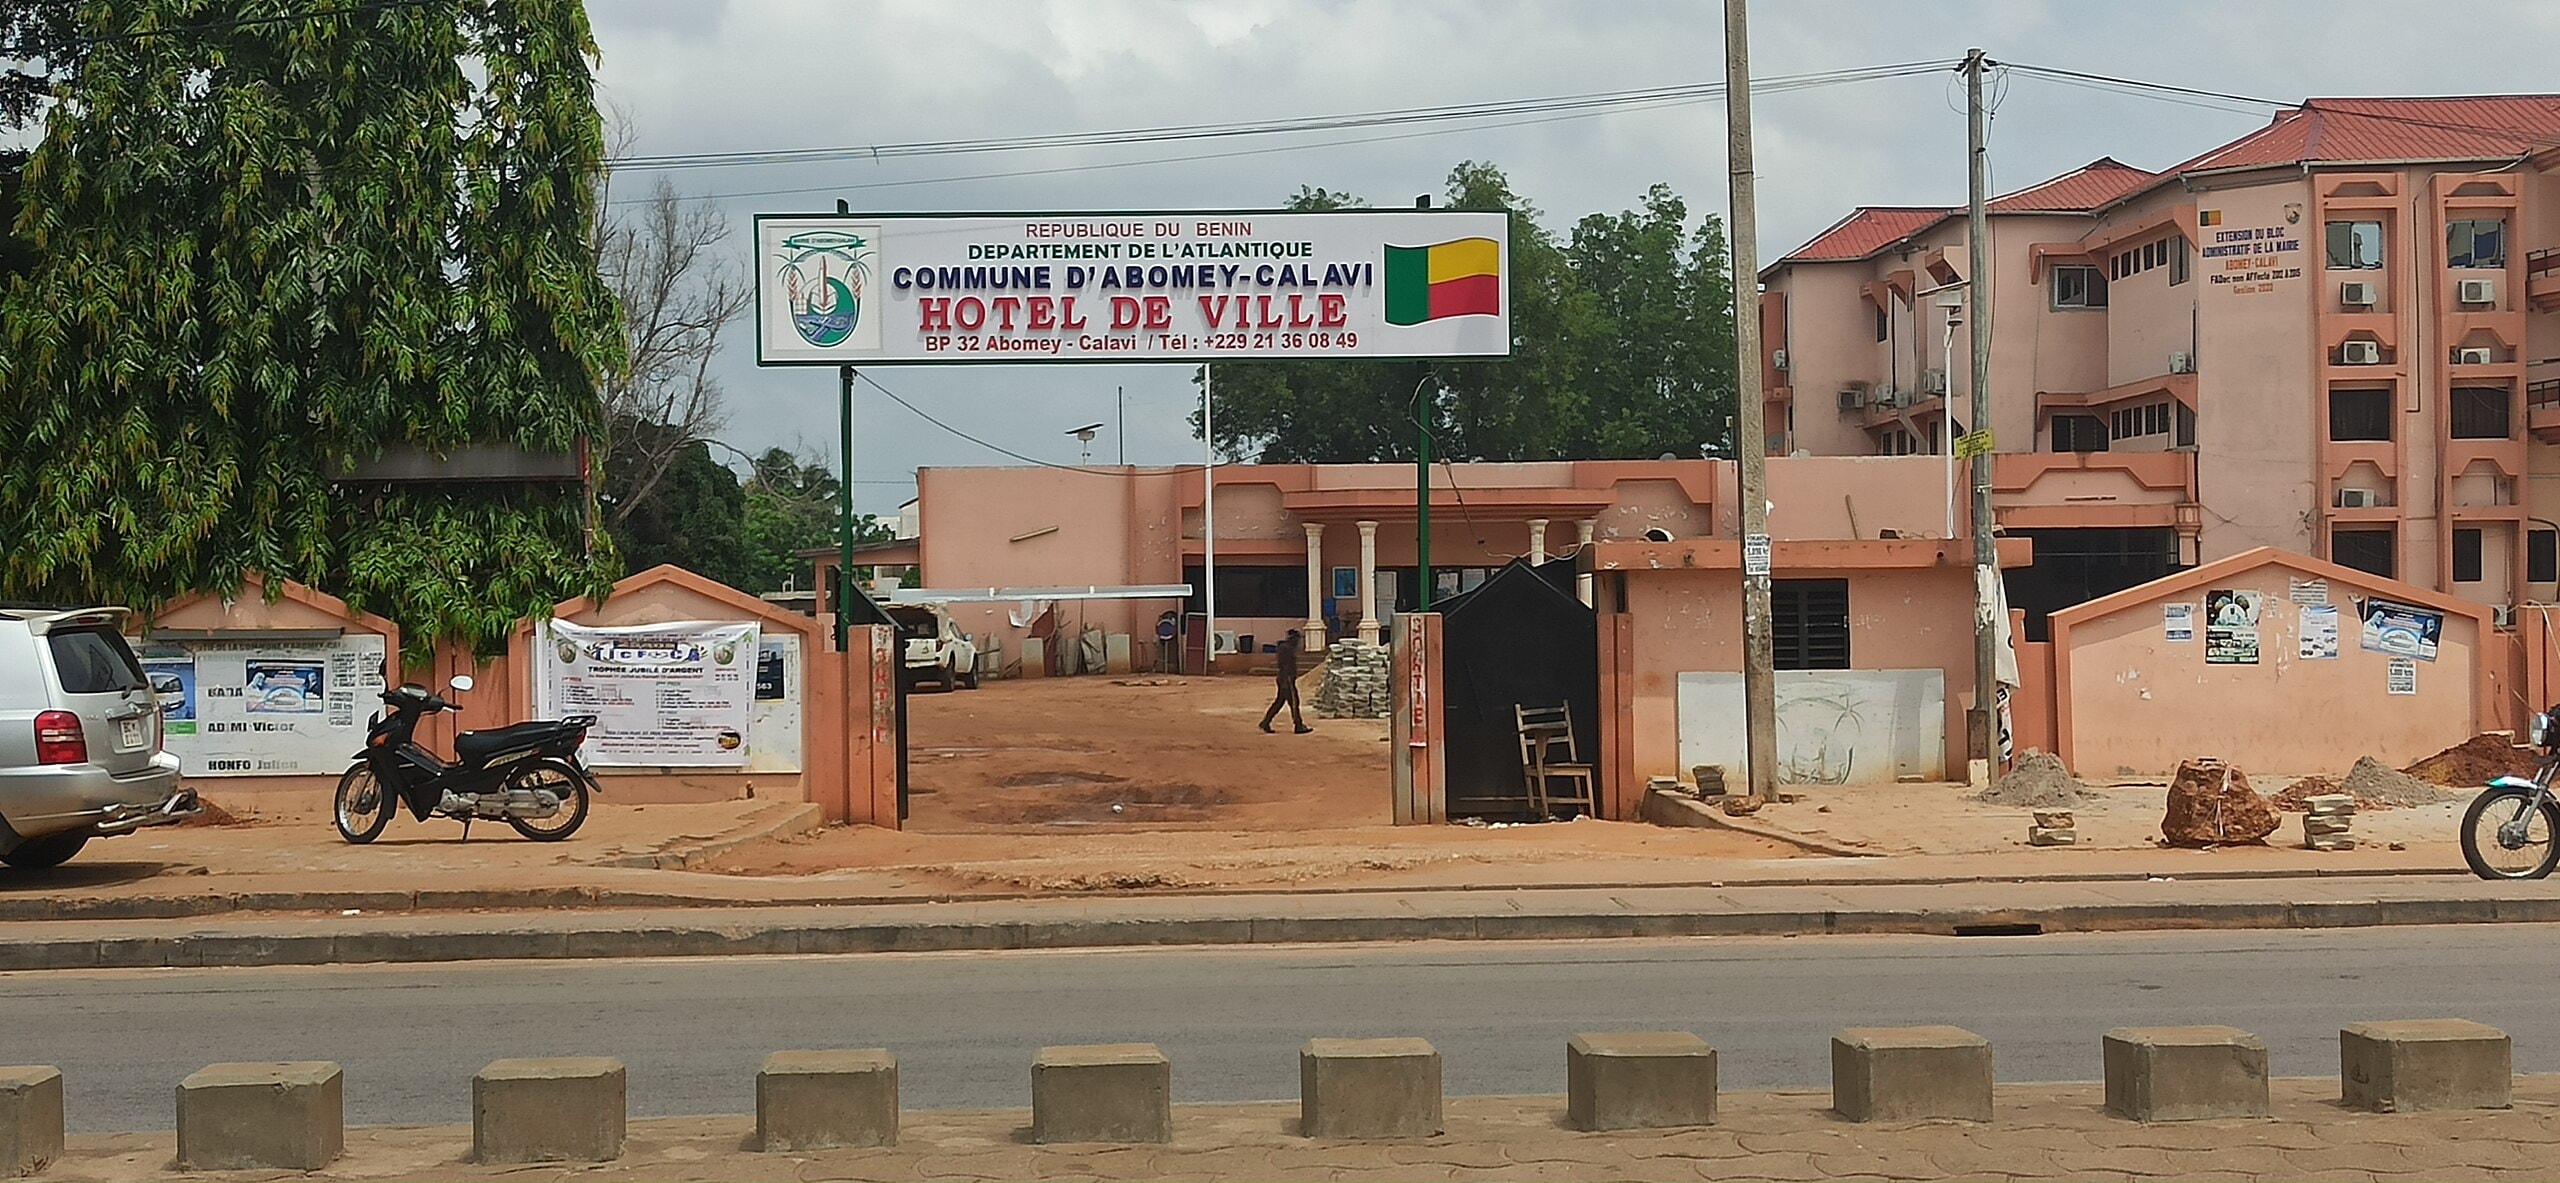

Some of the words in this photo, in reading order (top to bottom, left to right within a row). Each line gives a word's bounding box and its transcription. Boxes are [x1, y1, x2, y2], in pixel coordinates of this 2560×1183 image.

[1026, 223, 1144, 238] REPUBLIQUE
[1155, 223, 1180, 236] DU
[1196, 222, 1252, 236] BENIN
[2216, 230, 2252, 242] EXTENSION
[2255, 229, 2264, 239] DU
[2267, 226, 2284, 238] BLOC
[968, 244, 1121, 259] DEPARTEMENT
[1129, 243, 1155, 258] DE
[1162, 242, 1312, 259] L'ATLANTIQUE
[2202, 244, 2250, 257] ADMINISTRATIF
[2253, 243, 2262, 254] DE
[2265, 242, 2273, 253] LA
[2276, 240, 2299, 252] MAIRIE
[893, 266, 1051, 290] COMMUNE
[1067, 263, 1373, 289] D'ABOMEY-CALAVI
[919, 296, 1087, 331] HOTEL
[1110, 296, 1172, 330] DE
[1198, 294, 1348, 329] VILLE
[925, 336, 950, 351] BP
[957, 336, 980, 351] 32
[986, 336, 1061, 354] Abomey
[1079, 335, 1136, 351] Calavi
[1158, 334, 1187, 350] Tél
[1204, 333, 1247, 349] +229
[1253, 333, 1274, 349] 21
[1281, 333, 1301, 348] 36
[1309, 333, 1330, 348] 08
[1336, 333, 1358, 348] 49
[208, 760, 251, 771] HONFO
